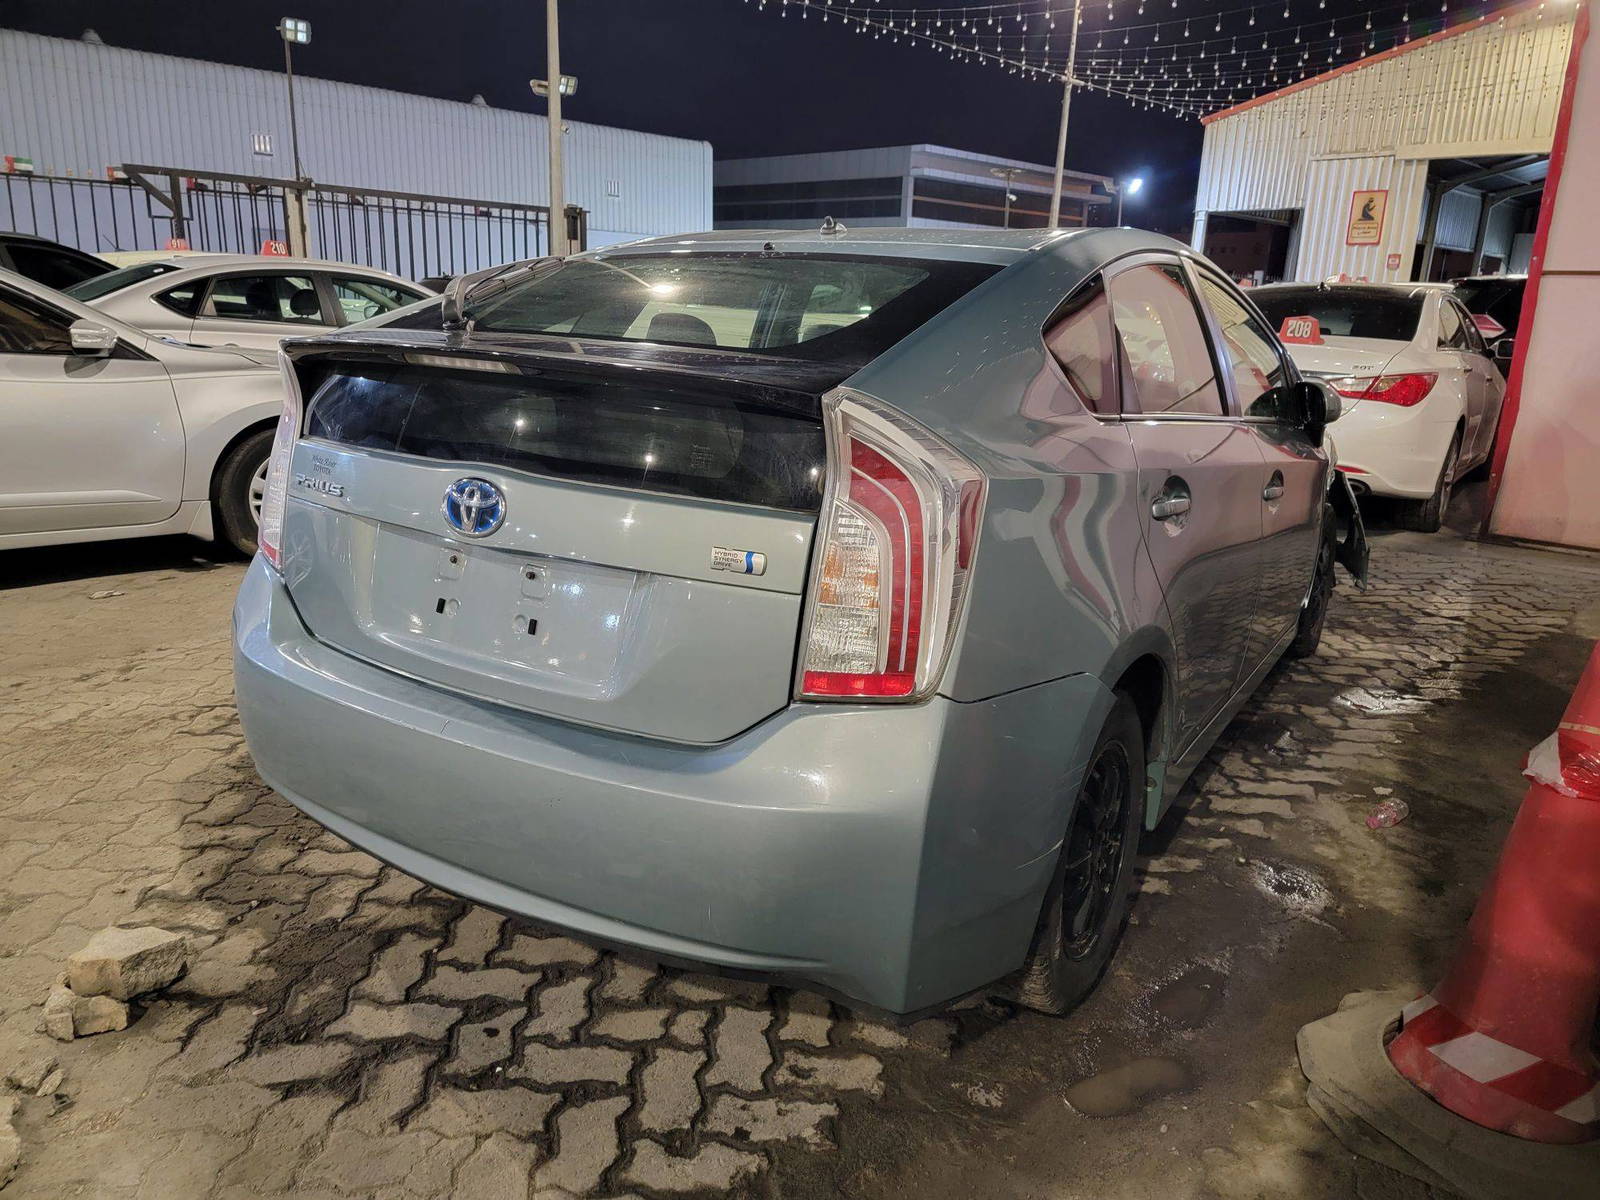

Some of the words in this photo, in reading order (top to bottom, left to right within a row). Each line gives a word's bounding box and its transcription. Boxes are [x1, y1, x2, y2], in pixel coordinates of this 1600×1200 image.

[270, 240, 286, 255] 210
[1286, 319, 1312, 338] 208
[296, 472, 344, 497] PRIUS
[713, 555, 743, 564] SYNERGY
[714, 551, 739, 559] HYBRID
[713, 560, 733, 568] DRIVE
